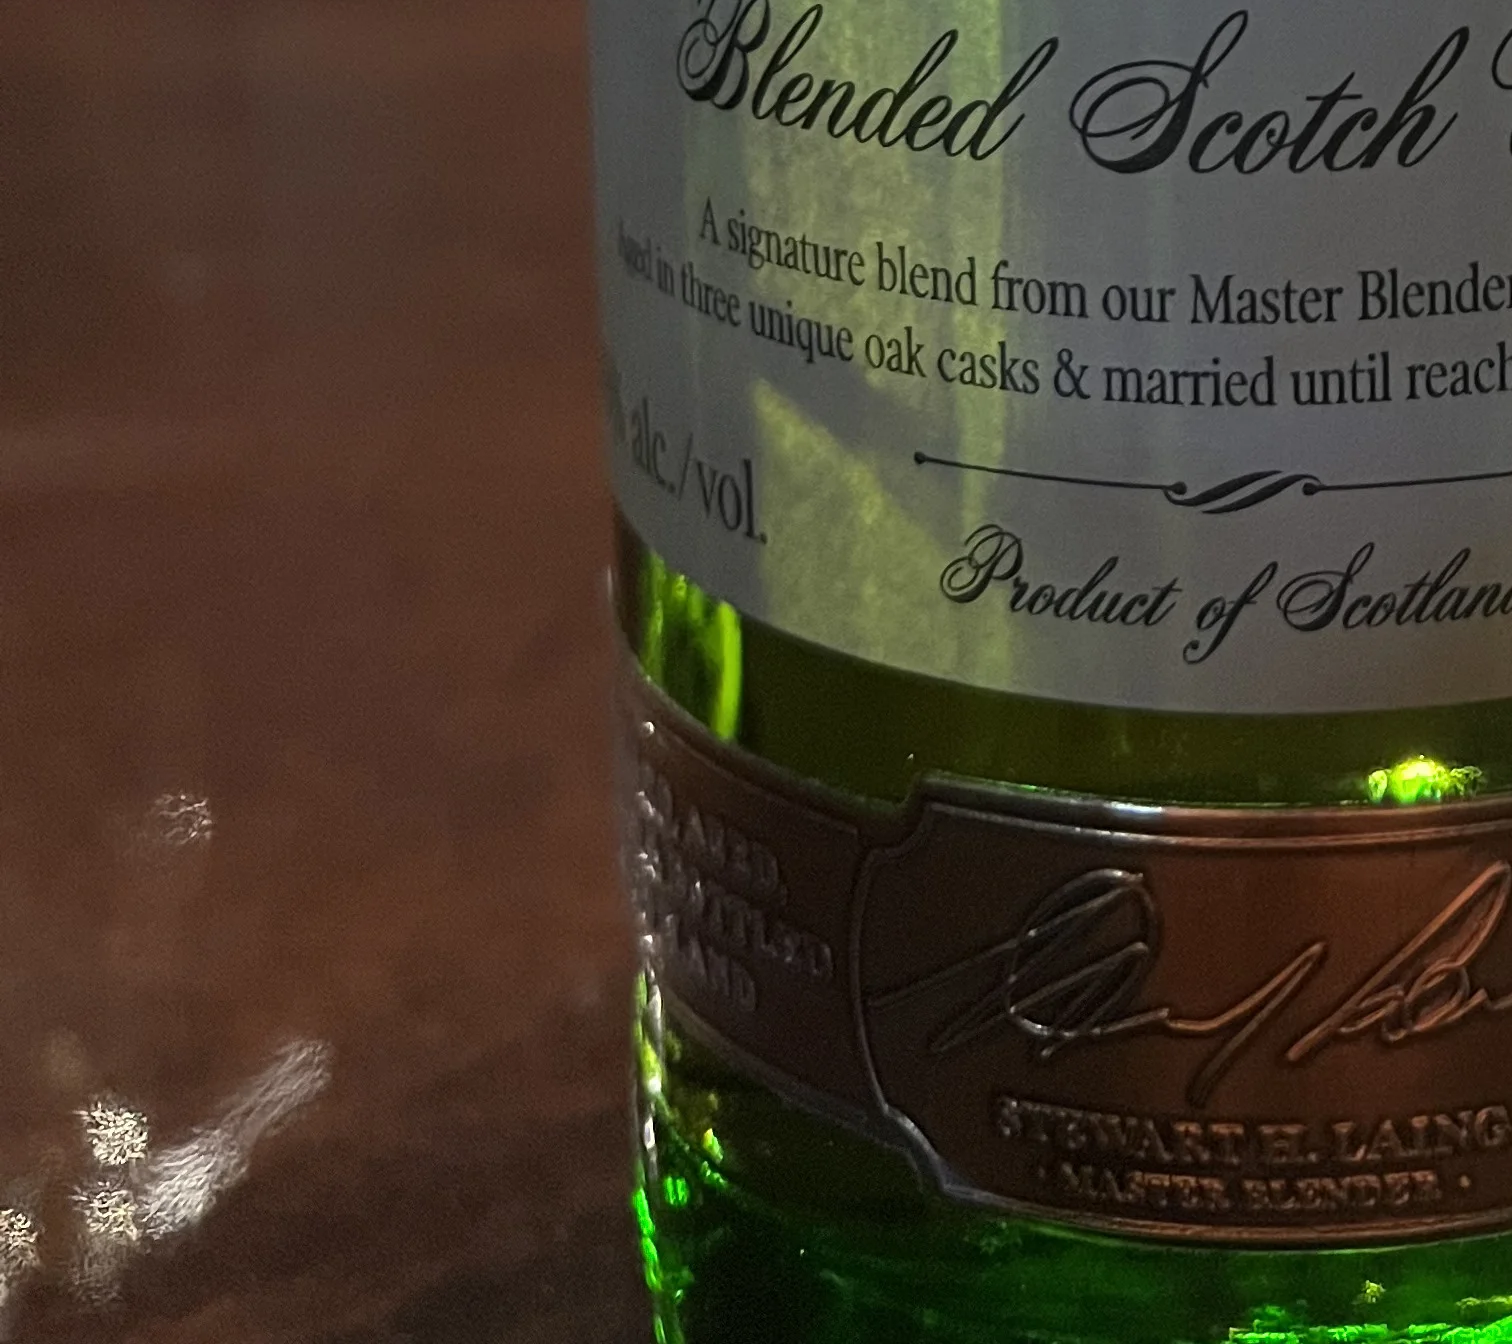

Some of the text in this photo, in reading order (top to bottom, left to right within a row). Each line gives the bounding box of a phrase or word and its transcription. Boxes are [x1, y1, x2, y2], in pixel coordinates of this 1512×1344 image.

[1069, 9, 1470, 175] Scotch
[655, 246, 676, 298] in
[680, 260, 742, 328] three
[748, 299, 855, 365] unique
[864, 325, 928, 379] oak
[937, 340, 1040, 396] casks
[1052, 347, 1092, 401] &
[1102, 355, 1278, 407] married
[1289, 350, 1392, 406] until
[700, 195, 722, 246] A
[728, 208, 866, 287] signature
[875, 240, 979, 307] blend
[991, 259, 1090, 319] from
[1101, 282, 1176, 323] our
[1189, 272, 1344, 325] Master
[938, 523, 1182, 627] Product
[1181, 560, 1279, 666] of
[1331, 1104, 1512, 1164] LAING
